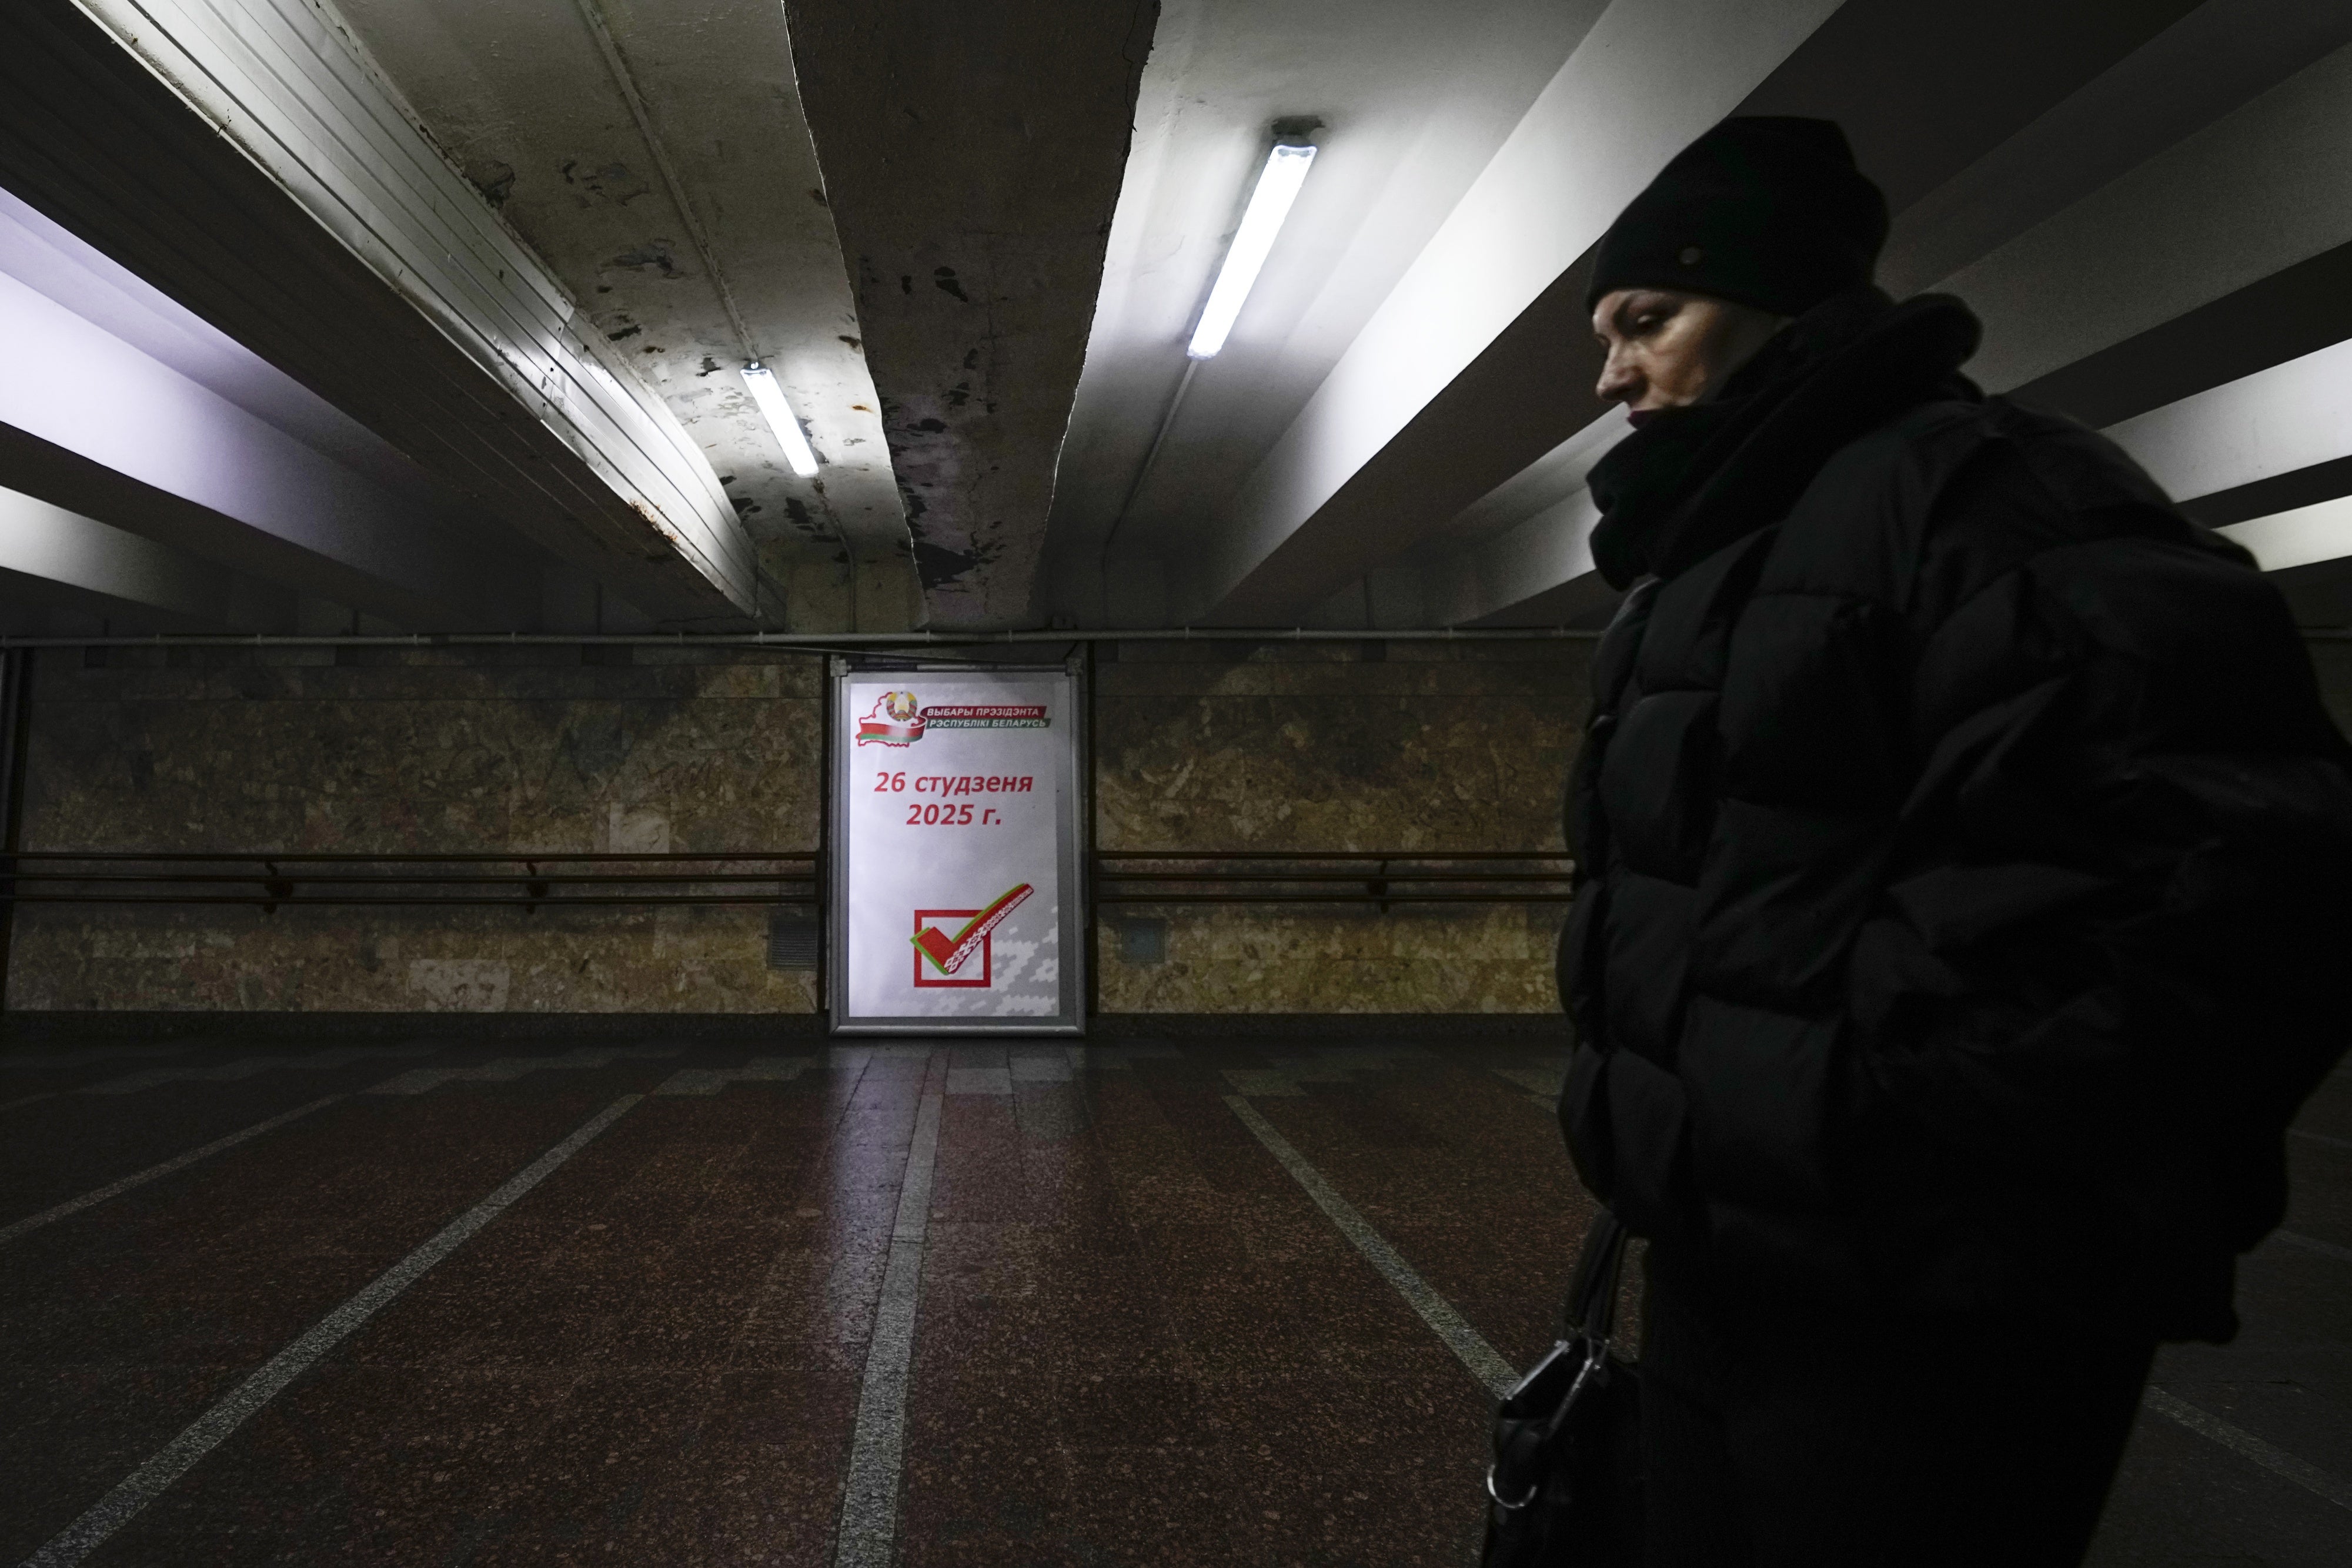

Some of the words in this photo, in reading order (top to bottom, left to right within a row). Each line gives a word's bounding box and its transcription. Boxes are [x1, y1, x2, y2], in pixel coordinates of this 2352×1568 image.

[927, 708, 973, 716] ВЫБАРЫ
[975, 708, 1039, 717] ПРЭЗІДЭНТА
[929, 719, 990, 727] РЭСПУБЛІКІ
[992, 719, 1046, 727] БЕЛАРУСЬ
[874, 772, 906, 792] 26
[914, 776, 1033, 797] студзеня
[906, 804, 974, 825] 2025
[982, 809, 1001, 825] г.
